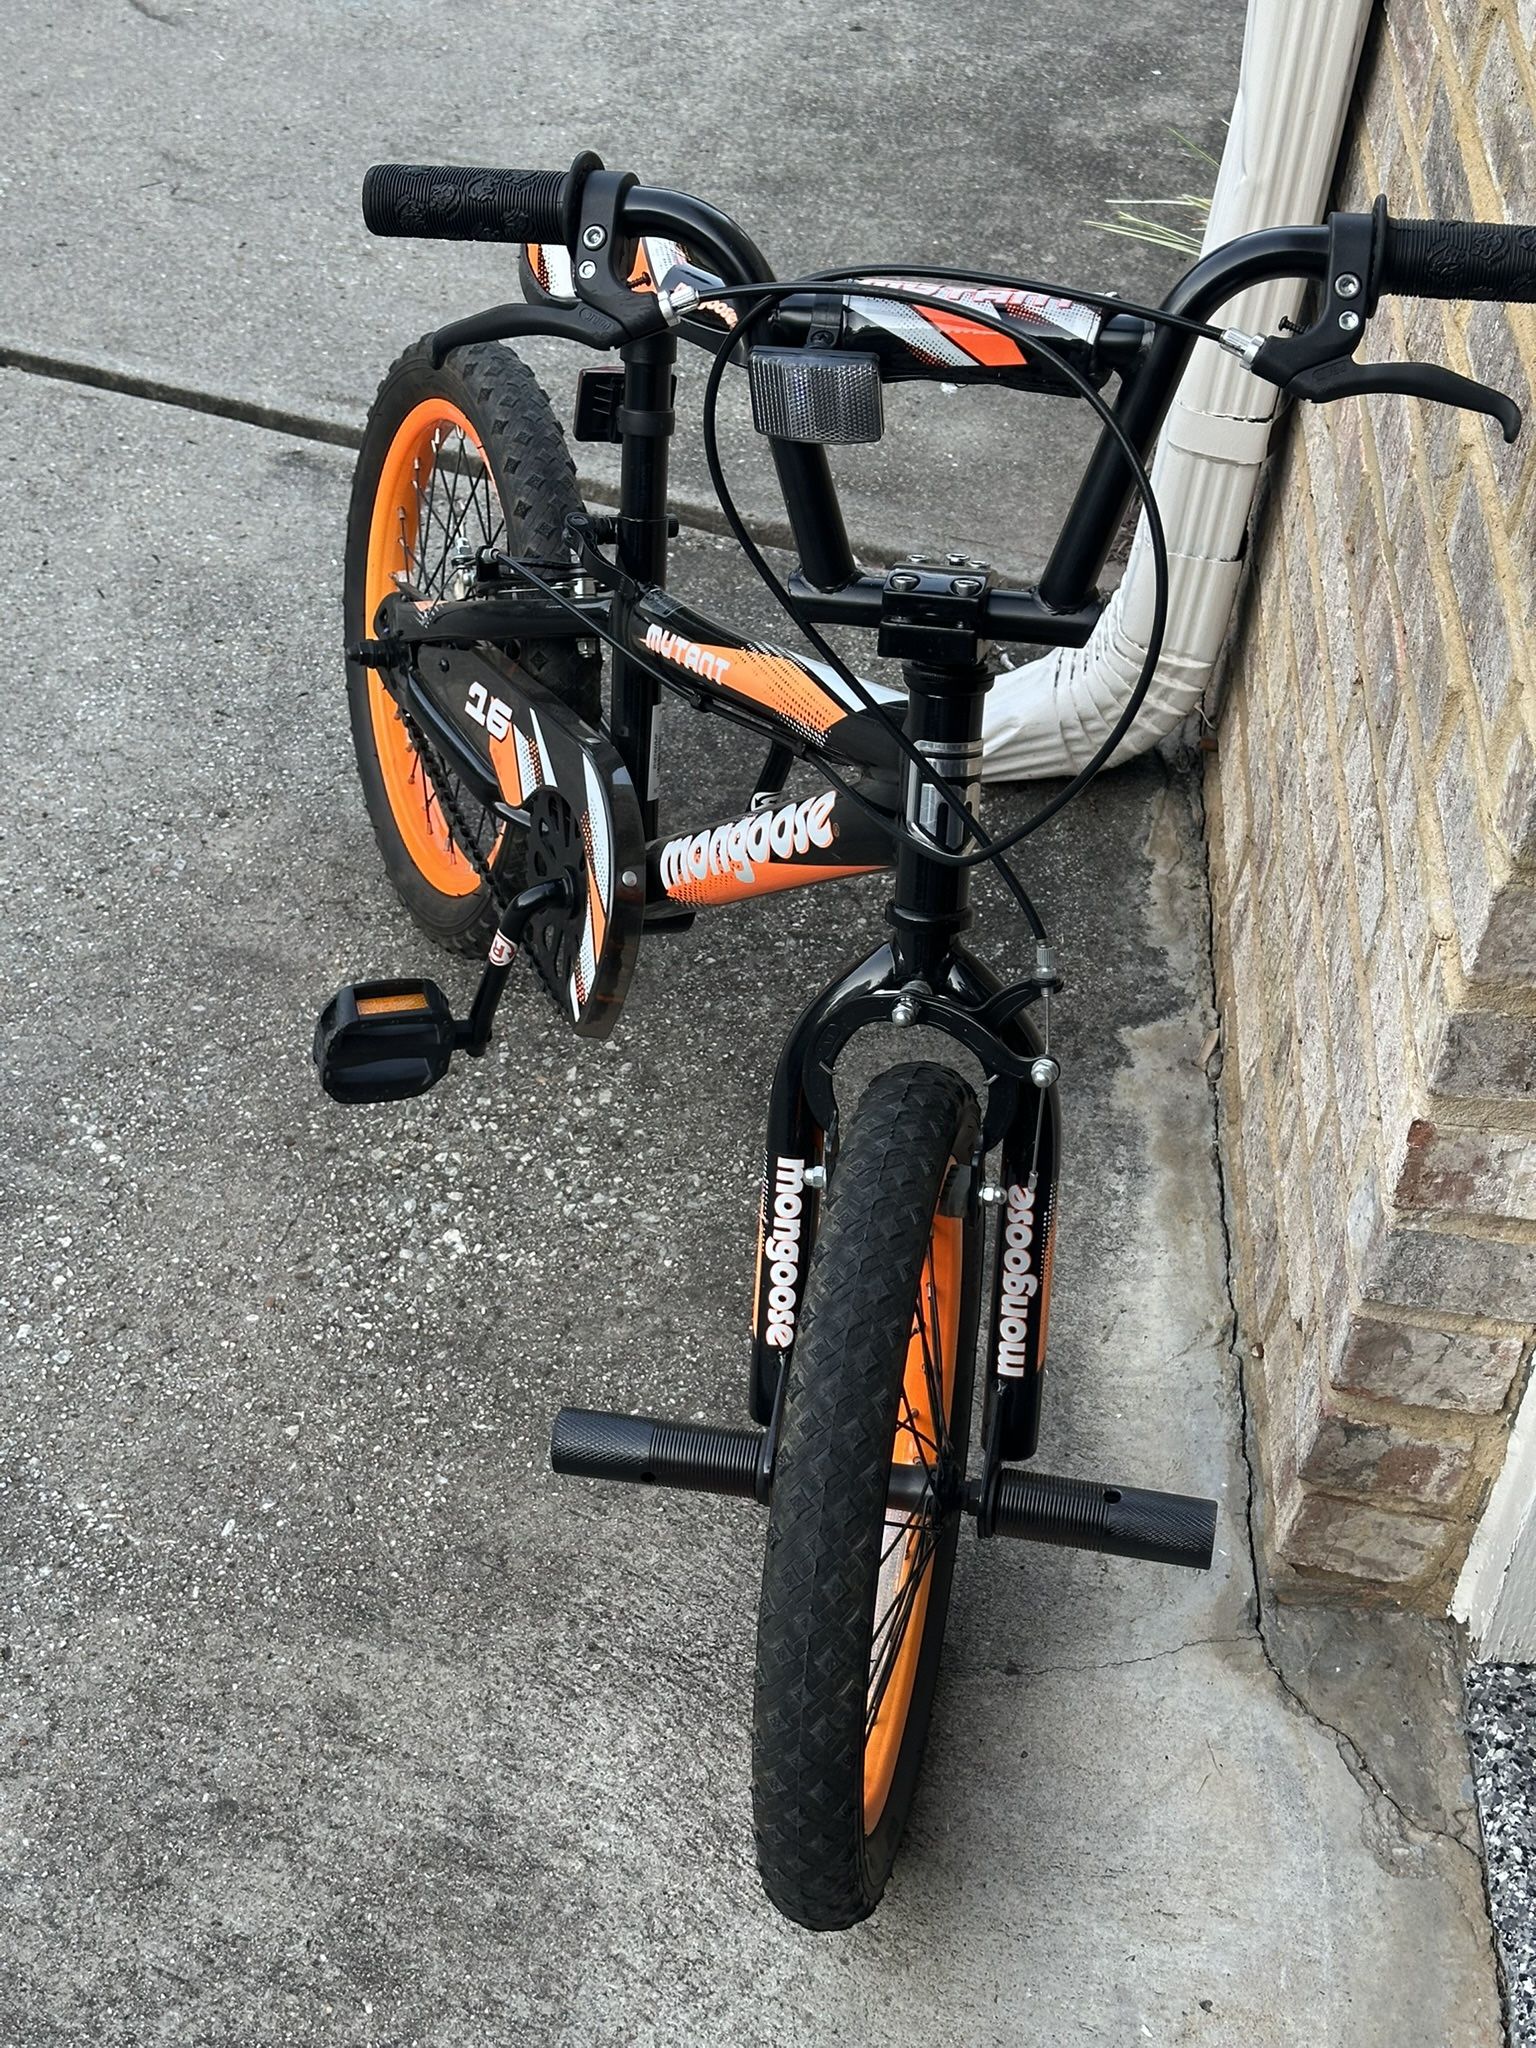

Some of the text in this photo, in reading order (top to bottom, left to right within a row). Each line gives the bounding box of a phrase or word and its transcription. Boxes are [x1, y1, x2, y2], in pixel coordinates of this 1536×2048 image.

[645, 623, 731, 685] MUTANT
[660, 790, 837, 884] mongoose
[765, 1156, 805, 1347] mongoose
[997, 1184, 1038, 1378] mongoose
